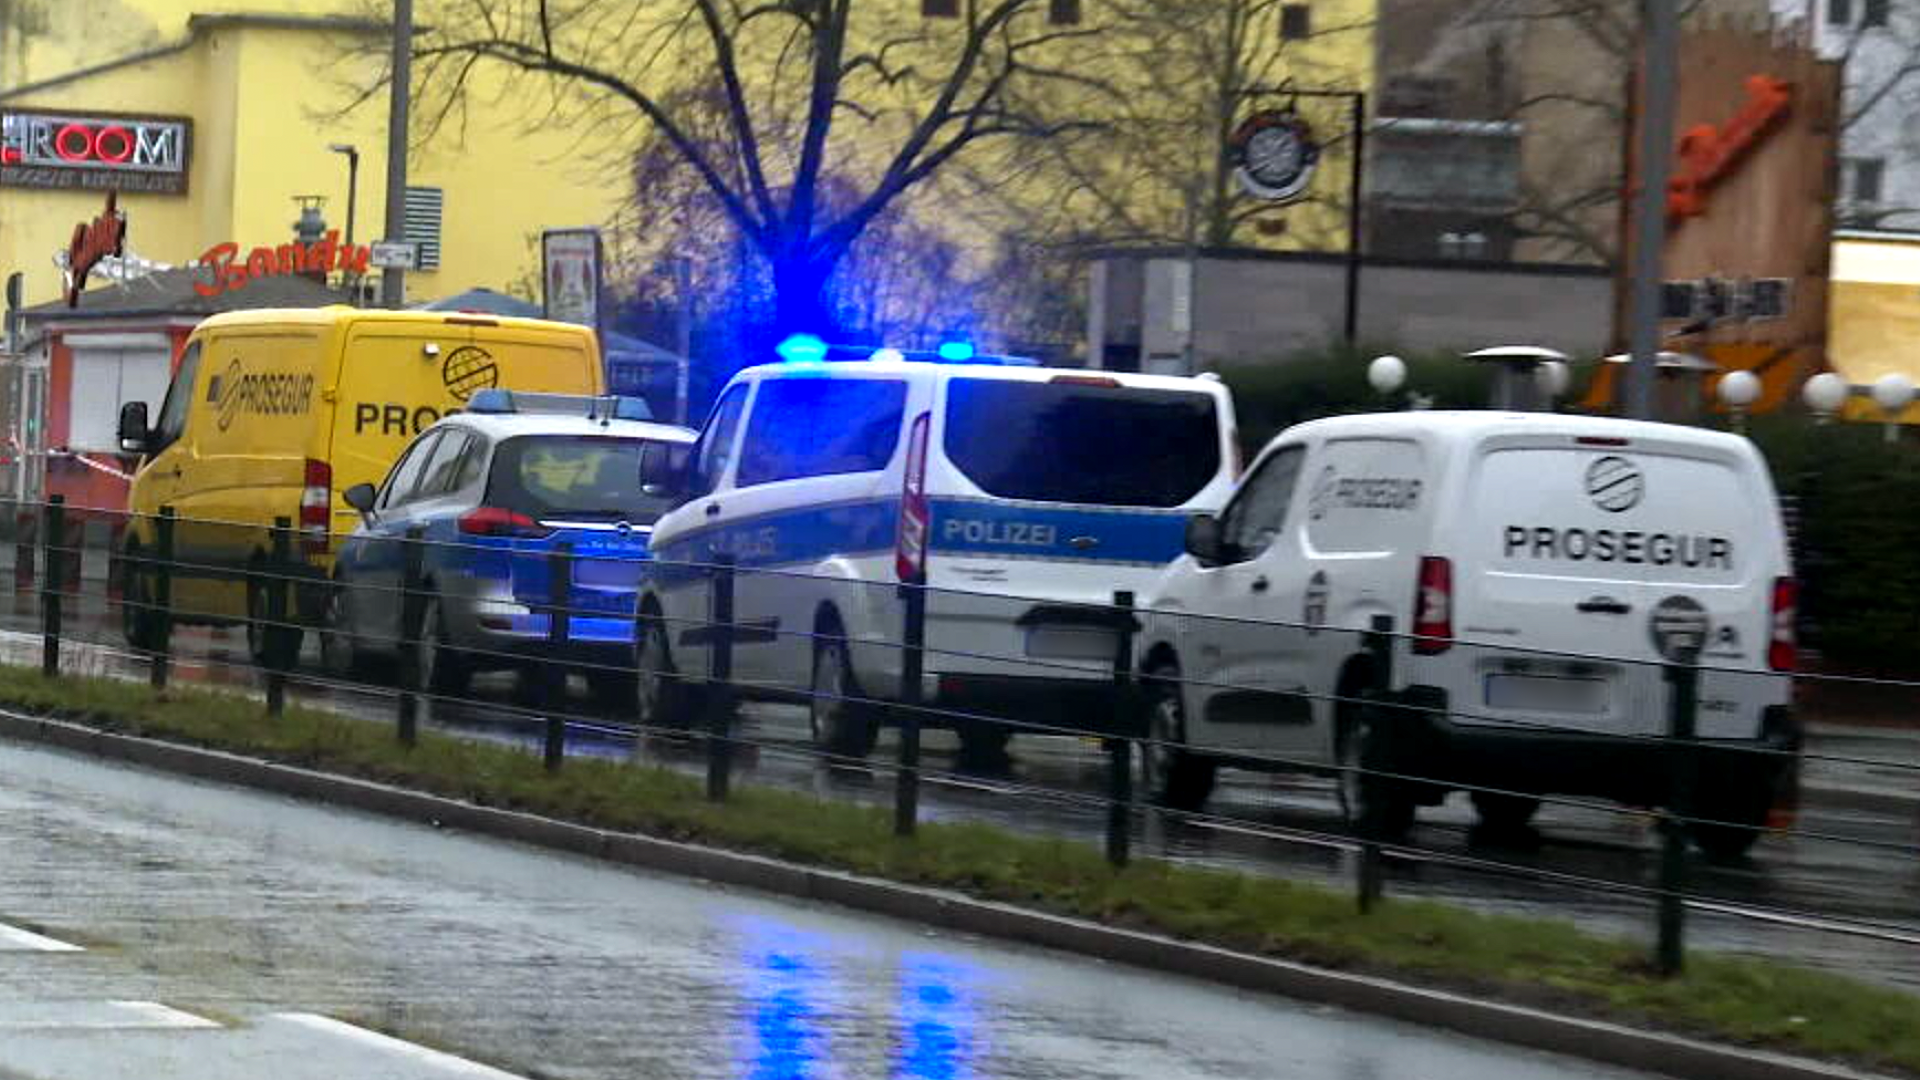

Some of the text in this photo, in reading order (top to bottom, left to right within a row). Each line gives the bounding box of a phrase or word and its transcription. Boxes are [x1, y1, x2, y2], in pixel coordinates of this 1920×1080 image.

[29, 119, 173, 164] ROOM
[240, 373, 314, 415] PROSEGUR
[356, 401, 461, 436] PRO
[944, 519, 1057, 546] POLIZEI
[1504, 525, 1734, 571] PROSEGUR
